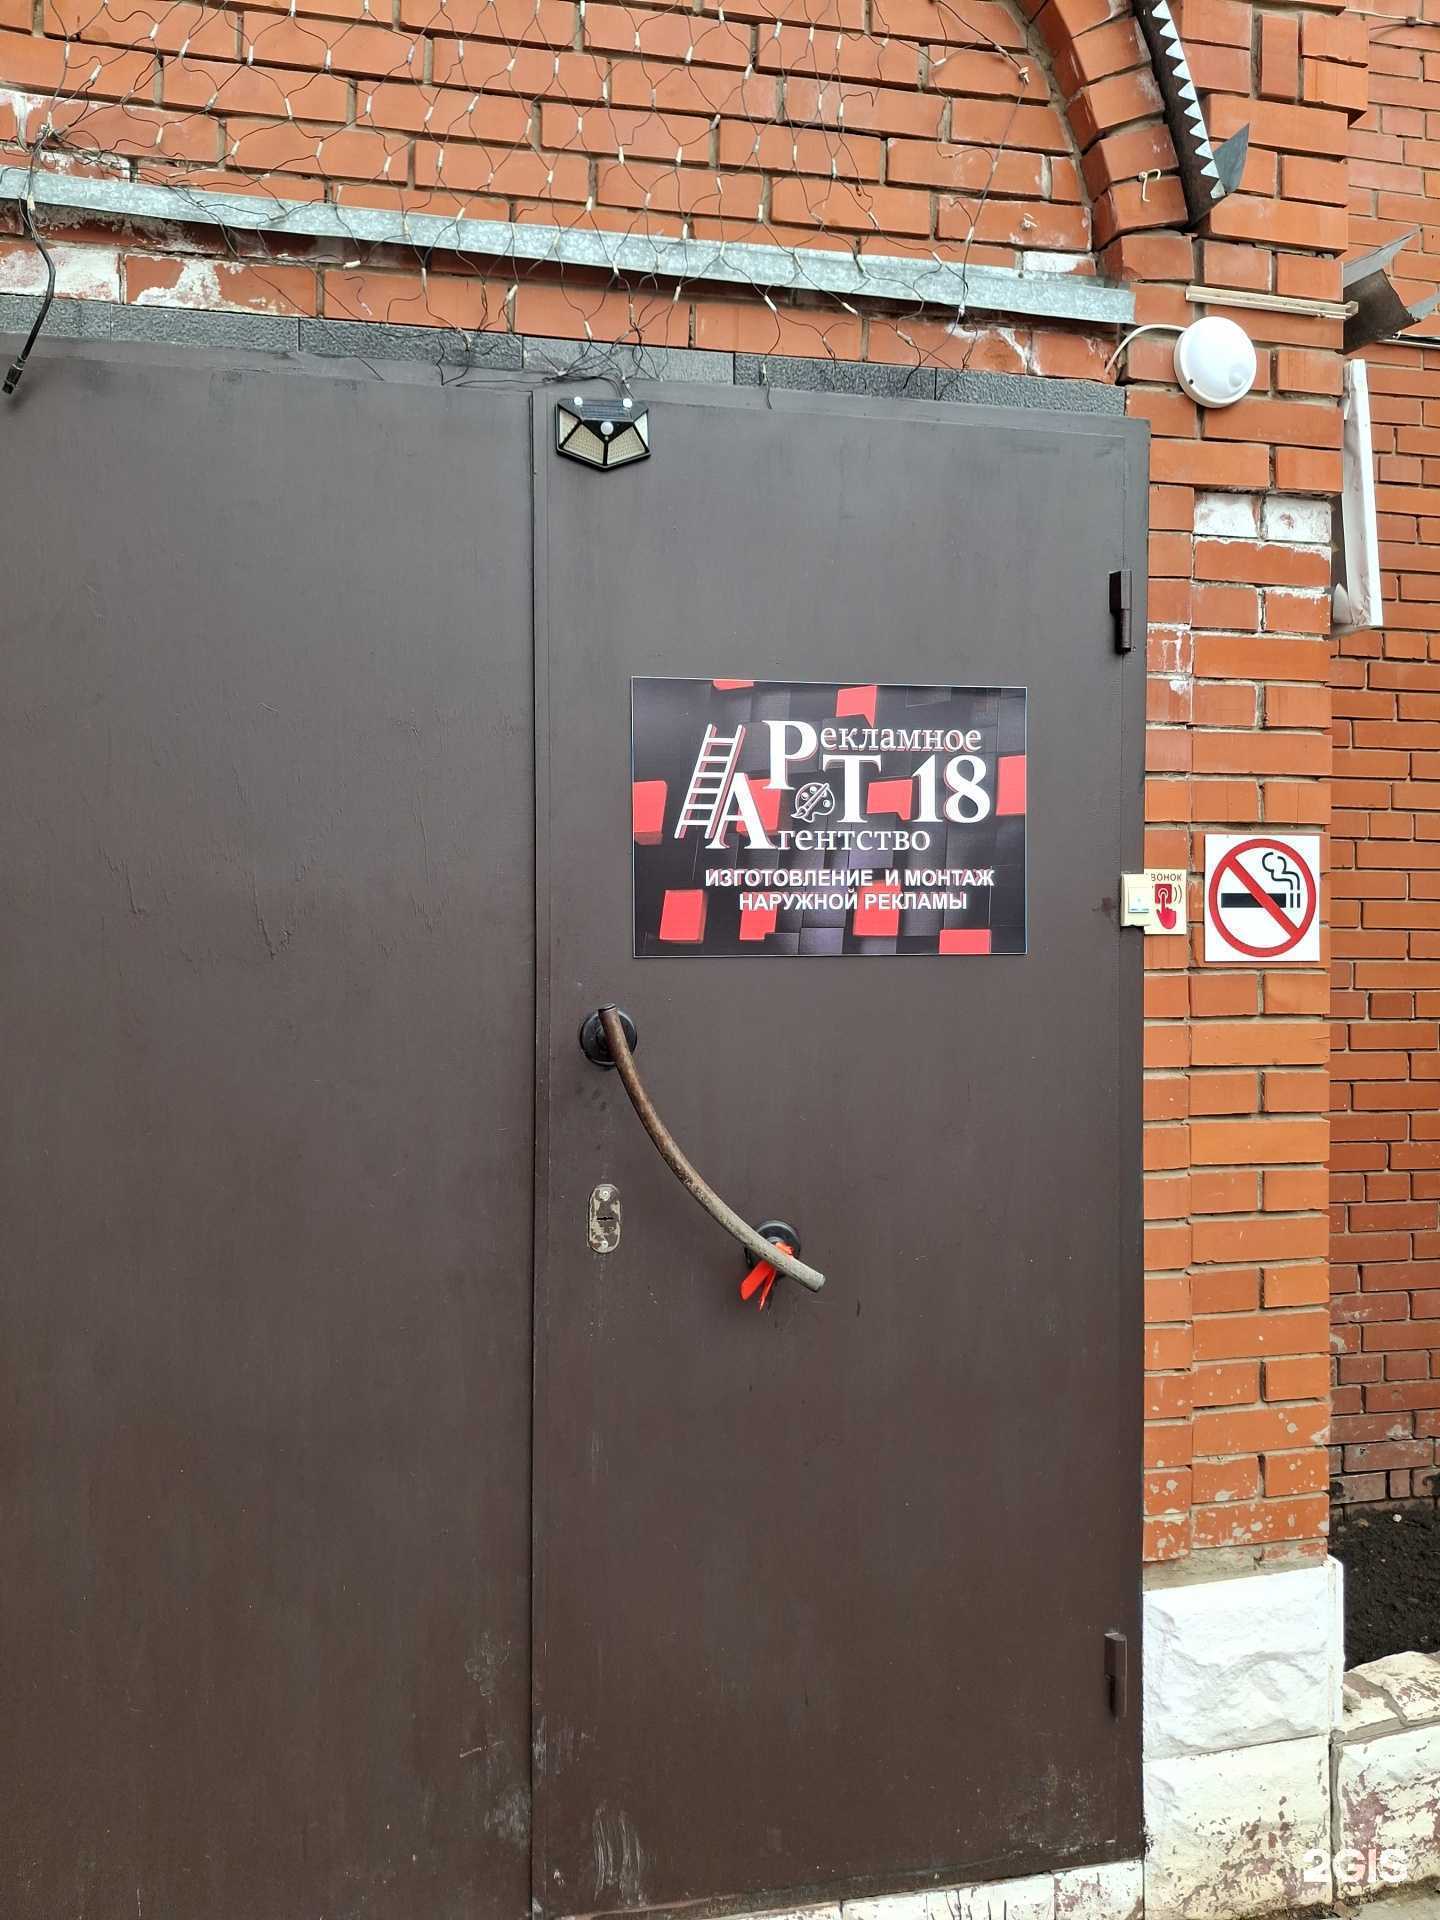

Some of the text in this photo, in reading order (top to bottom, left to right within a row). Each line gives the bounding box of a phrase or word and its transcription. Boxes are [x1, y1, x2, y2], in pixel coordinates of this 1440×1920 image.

[911, 754, 991, 824] 18
[704, 868, 995, 887] ИЗГОТОВЛЕНИЕ И МОНТАЖ
[738, 888, 968, 911] НАРУЖНОЙ РЕКЛАМЫ
